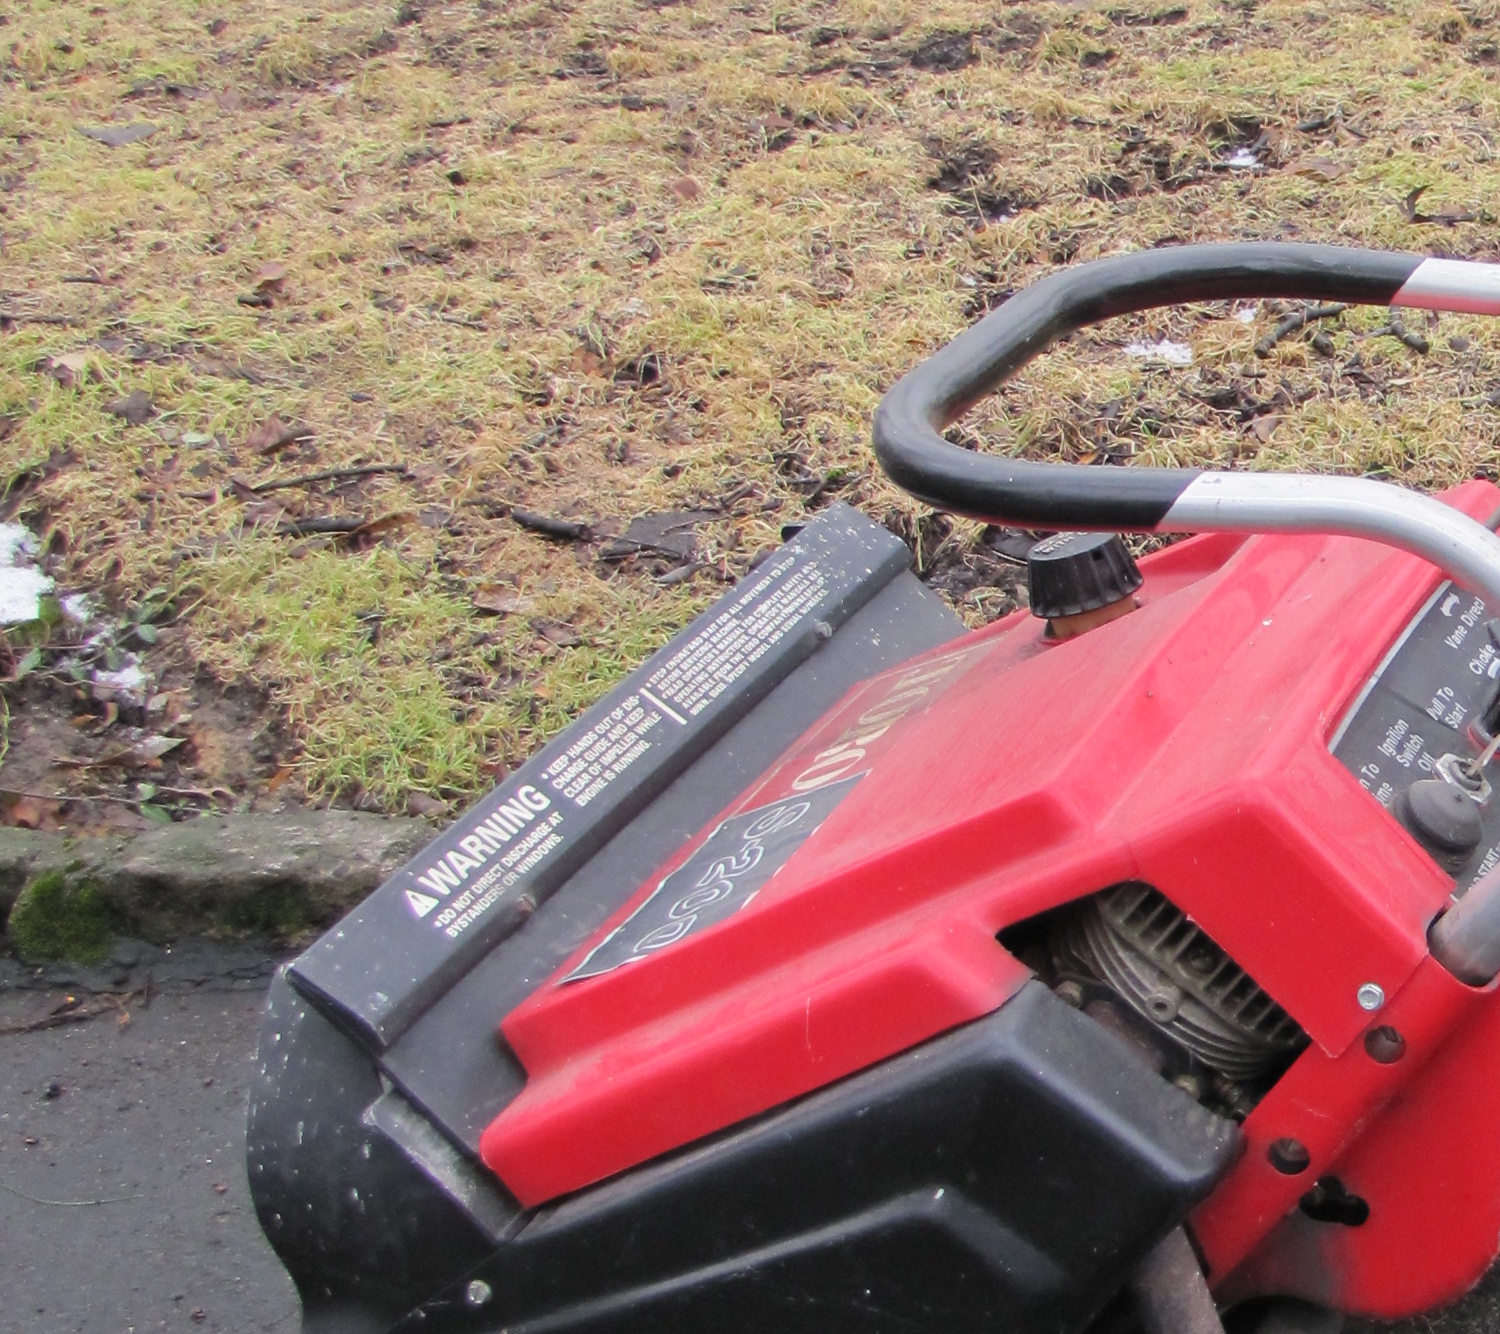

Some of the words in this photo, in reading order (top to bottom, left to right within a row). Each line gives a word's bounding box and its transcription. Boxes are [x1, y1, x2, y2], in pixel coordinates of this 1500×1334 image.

[650, 668, 667, 684] STOP
[666, 648, 690, 670] ENGINE
[688, 637, 703, 650] AND
[701, 623, 718, 638] WAIT
[716, 613, 731, 625] FOR
[729, 604, 742, 614] ALL
[740, 576, 772, 604] MOVEMENT
[770, 569, 781, 577] TO
[665, 680, 684, 696] READ
[717, 627, 744, 650] MANUAL
[741, 616, 755, 628] FOR
[754, 590, 784, 617] COMPLETE
[782, 573, 803, 592] SAFETY
[674, 671, 709, 702] OPERATING
[808, 570, 821, 580] ARE
[747, 643, 771, 662] MODEL
[768, 630, 783, 643] AND
[781, 614, 802, 632] SERIAL
[1444, 623, 1468, 650] Vane
[1469, 643, 1496, 675] Choke
[658, 669, 682, 690] BEFORE
[680, 642, 713, 670] SERVICING
[682, 679, 716, 708] AVAILABLE
[713, 663, 732, 680] FROM
[729, 652, 744, 664] THE
[741, 638, 759, 653] TORO
[547, 755, 569, 775] KEEP
[567, 731, 598, 758] HANDS
[595, 717, 613, 734] OUT
[611, 708, 624, 720] OF
[622, 696, 639, 710] DIS-
[792, 653, 968, 790] TORO
[1425, 692, 1446, 721] Pull
[1437, 685, 1455, 700] To
[1444, 703, 1468, 729] Start
[553, 758, 588, 789] CHARGE
[584, 738, 612, 761] GUIDE
[608, 724, 627, 740] AND
[624, 708, 644, 726] KEEP
[564, 773, 592, 797] CLEAR
[588, 762, 602, 775] OF
[599, 732, 639, 765] IMPELLER
[634, 711, 662, 734] WHILE
[1360, 762, 1380, 778] To
[1377, 718, 1410, 758] Ignition
[1396, 733, 1425, 768] Switch
[1417, 751, 1436, 772] Off
[575, 777, 608, 806] ENGINE
[603, 770, 615, 780] IS
[612, 740, 652, 773] RUNNING.
[418, 786, 550, 895] WARNING
[438, 909, 456, 924] DO
[452, 891, 474, 911] NOT
[471, 864, 504, 894] DIRECT
[501, 822, 552, 867] DISCHARGE
[548, 812, 563, 826] AT
[446, 884, 503, 937] BYSTANDERS
[503, 872, 519, 886] OR
[515, 834, 563, 873] WINDOWS.
